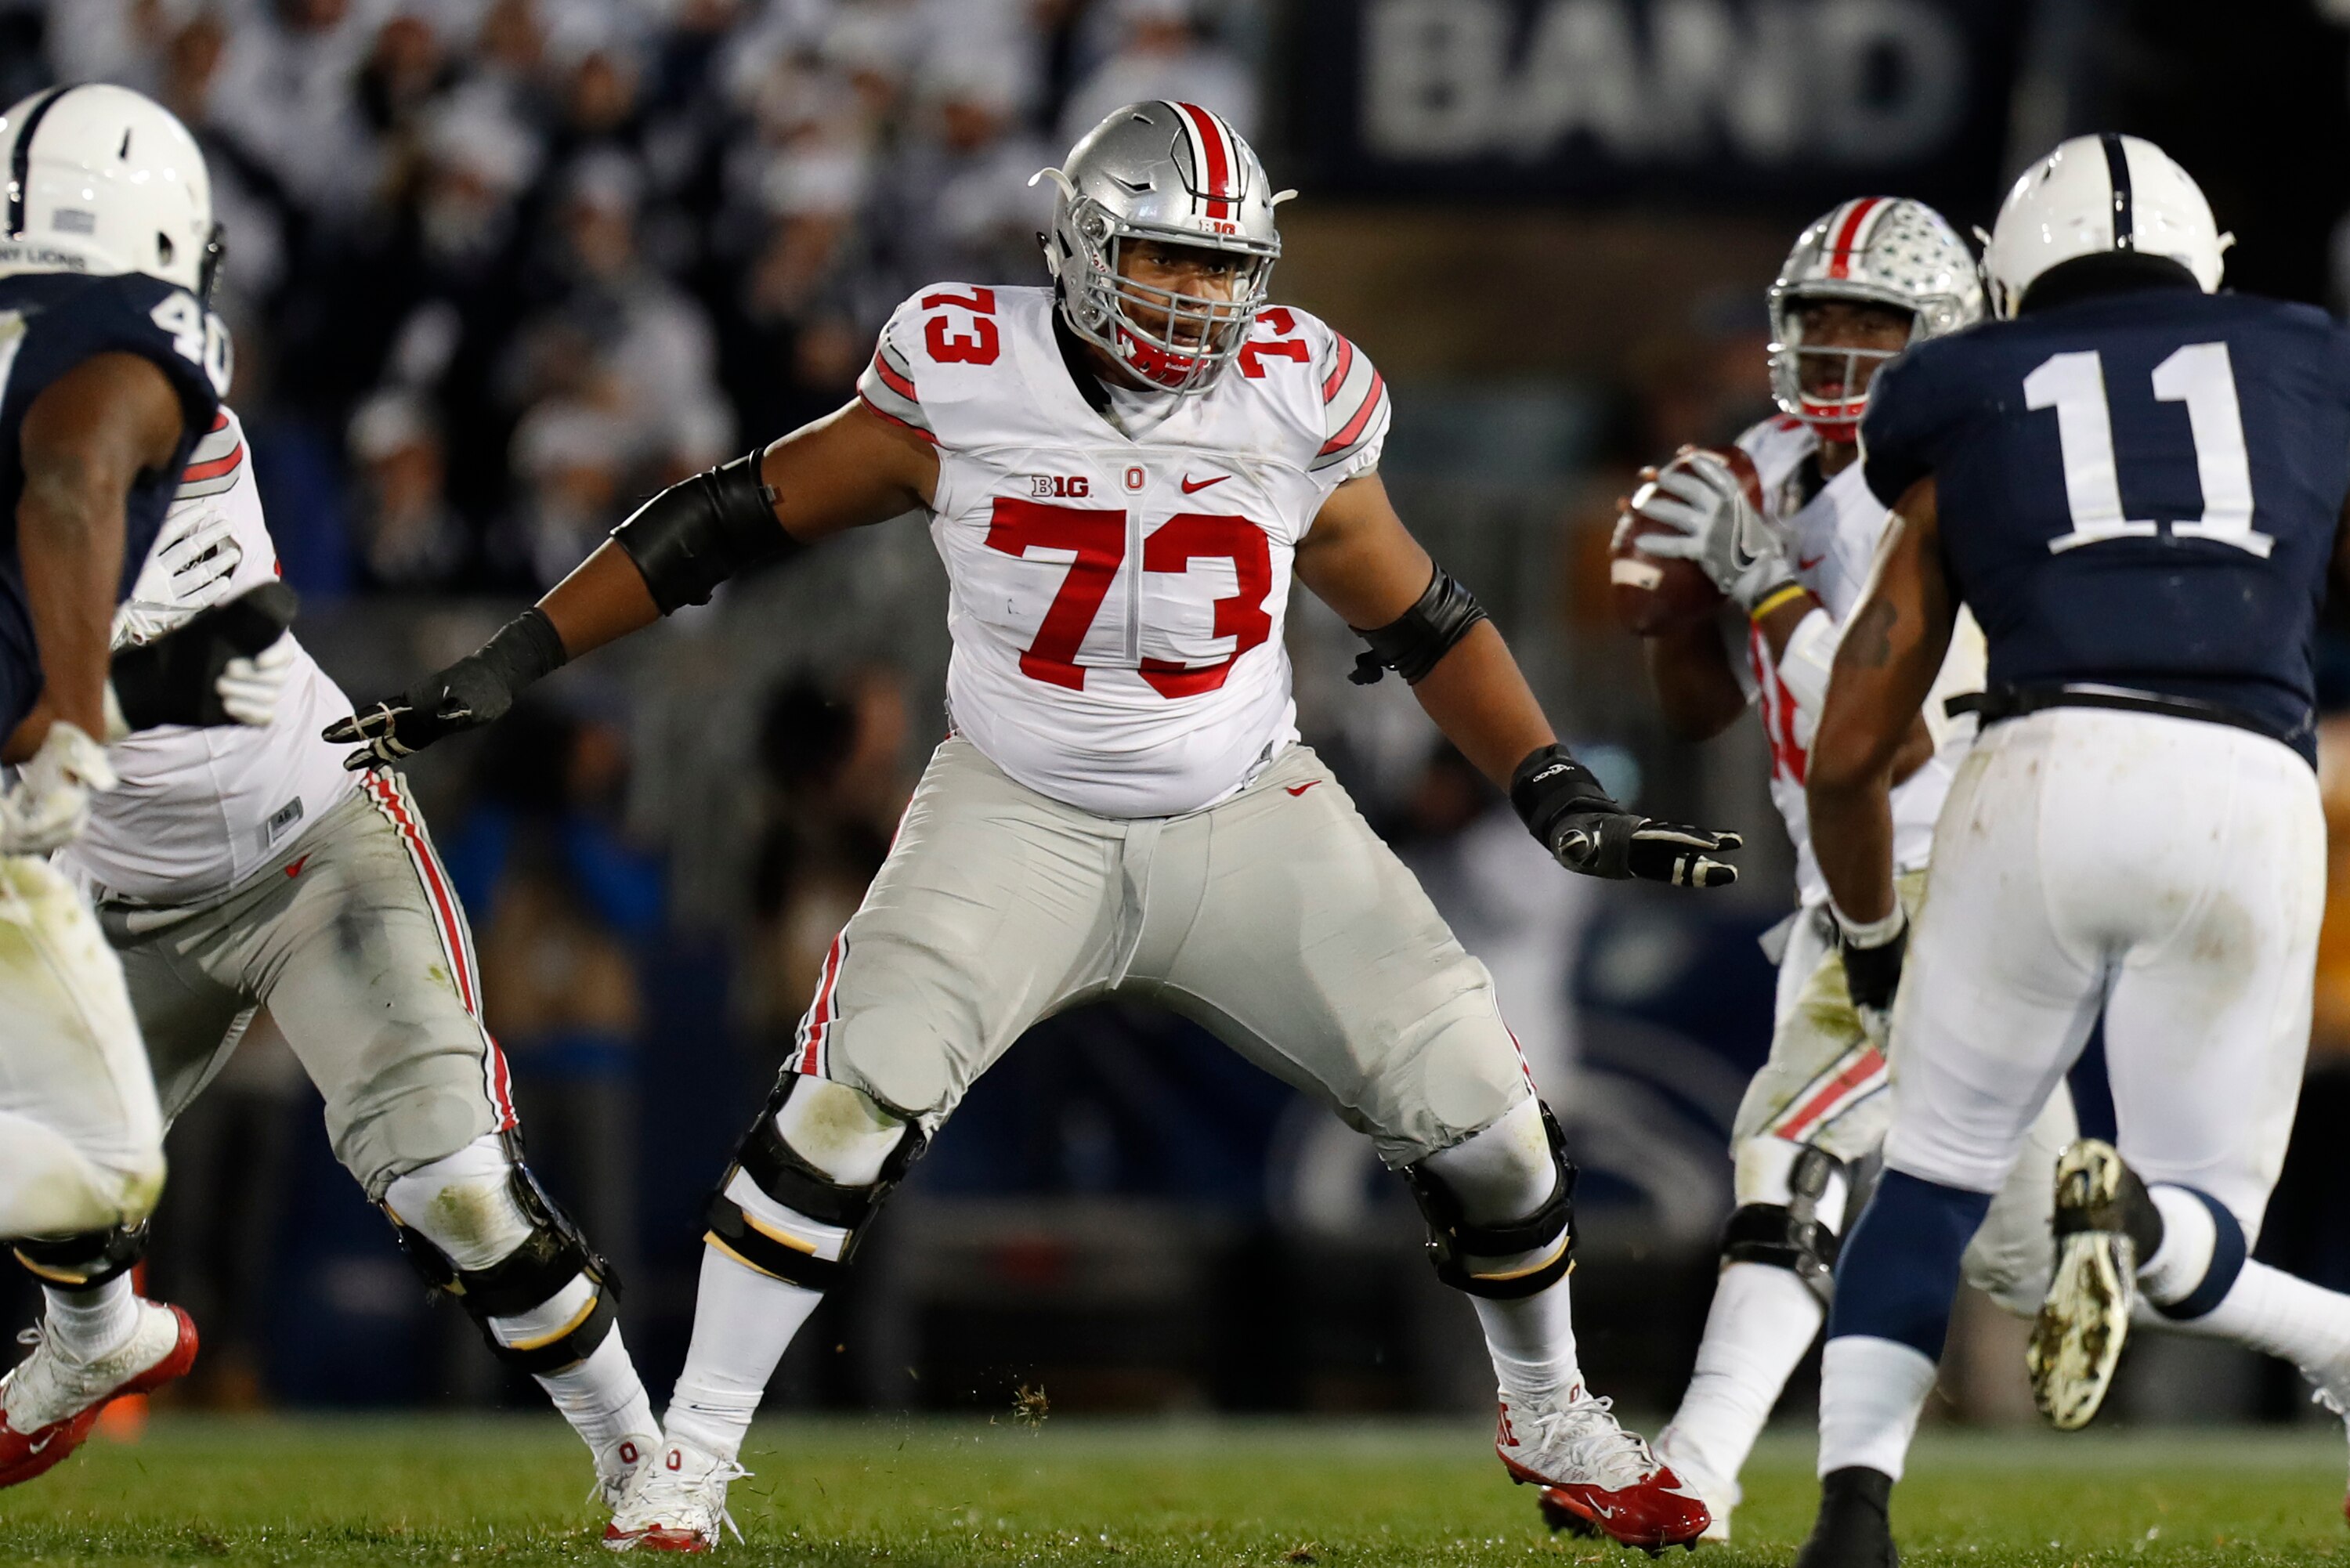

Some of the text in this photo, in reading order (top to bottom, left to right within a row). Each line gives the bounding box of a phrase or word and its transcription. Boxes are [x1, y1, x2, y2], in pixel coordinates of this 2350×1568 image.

[1361, 0, 1971, 159] BAND
[149, 289, 234, 398] 40
[921, 285, 1000, 366] 73
[2022, 340, 2276, 559] 11
[983, 497, 1273, 699] 73
